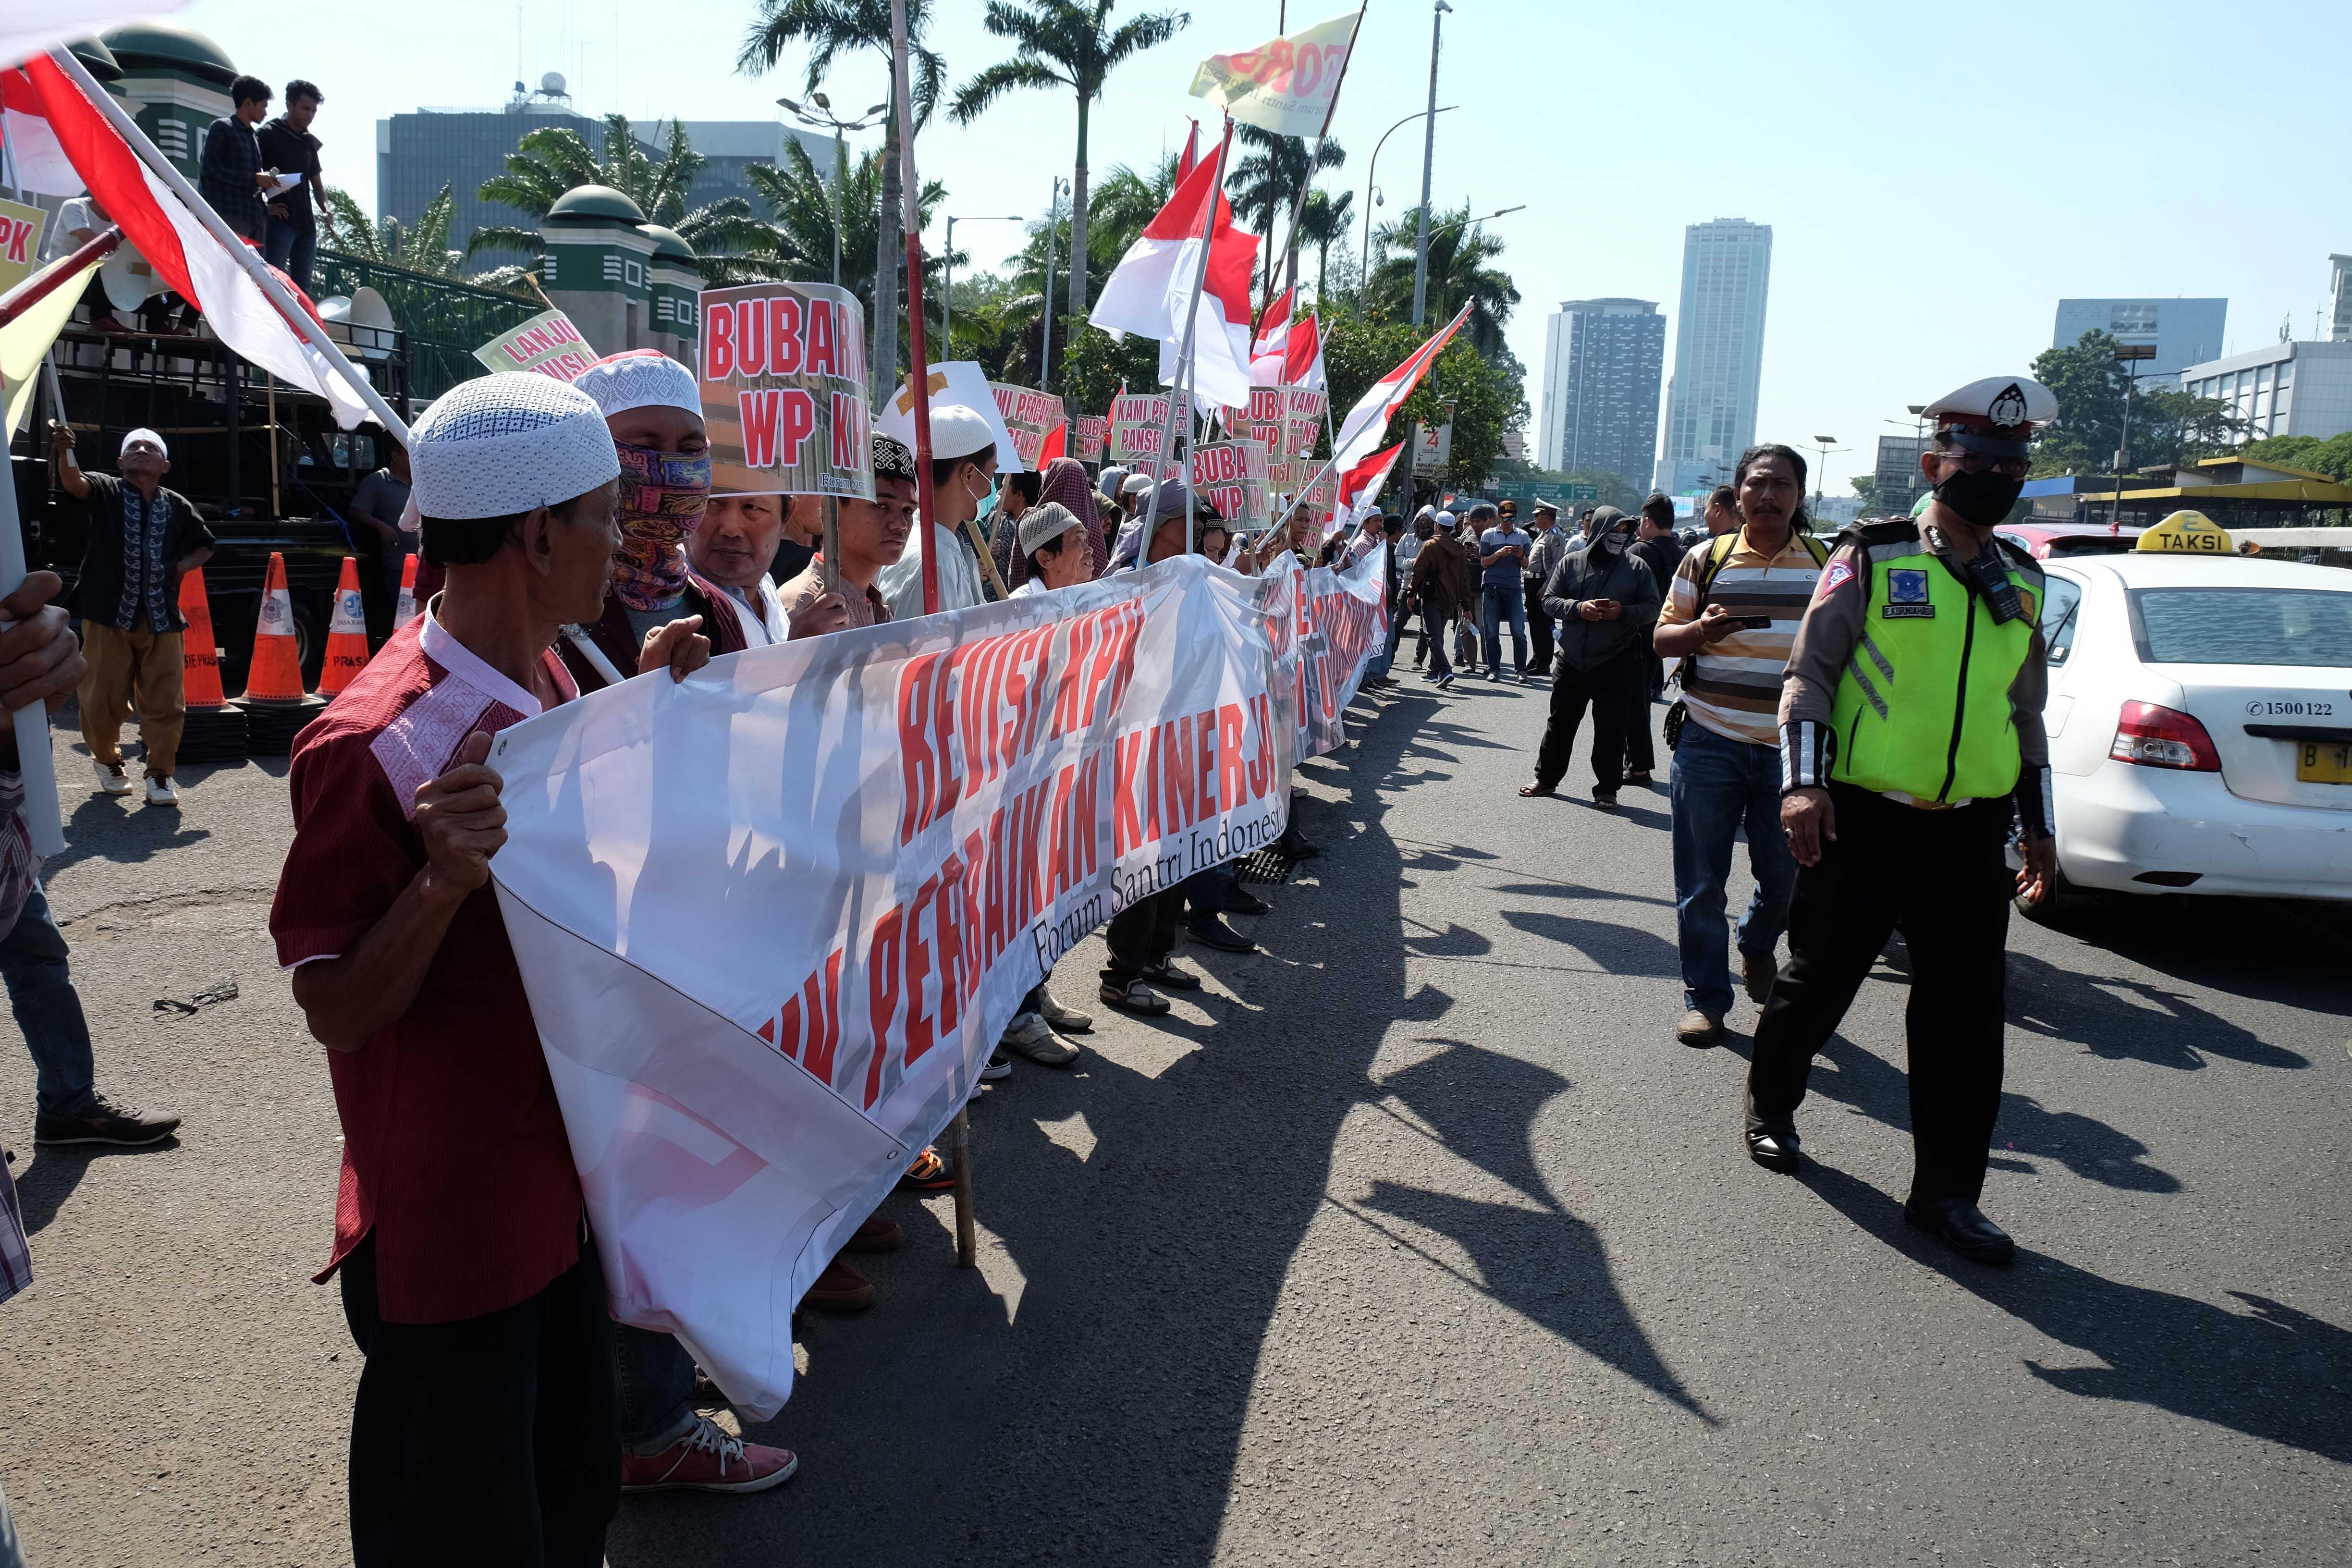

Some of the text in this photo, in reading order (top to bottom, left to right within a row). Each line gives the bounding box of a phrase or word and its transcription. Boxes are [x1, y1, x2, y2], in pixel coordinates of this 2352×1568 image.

[1117, 399, 1149, 422] KAMI
[1289, 390, 1320, 416] KAMI
[738, 388, 815, 469] WP
[1250, 426, 1280, 455] WP
[1083, 438, 1101, 457] WP
[820, 473, 850, 489] Forum
[1208, 485, 1244, 521] WP
[2159, 534, 2221, 550] TAKSI
[898, 617, 1072, 847] REVISI
[2304, 744, 2317, 767] B
[1031, 795, 1286, 979] Forum Santri Indonesia
[864, 752, 1098, 1113] PERBAIKAN
[1113, 692, 1275, 860] KINERJA
